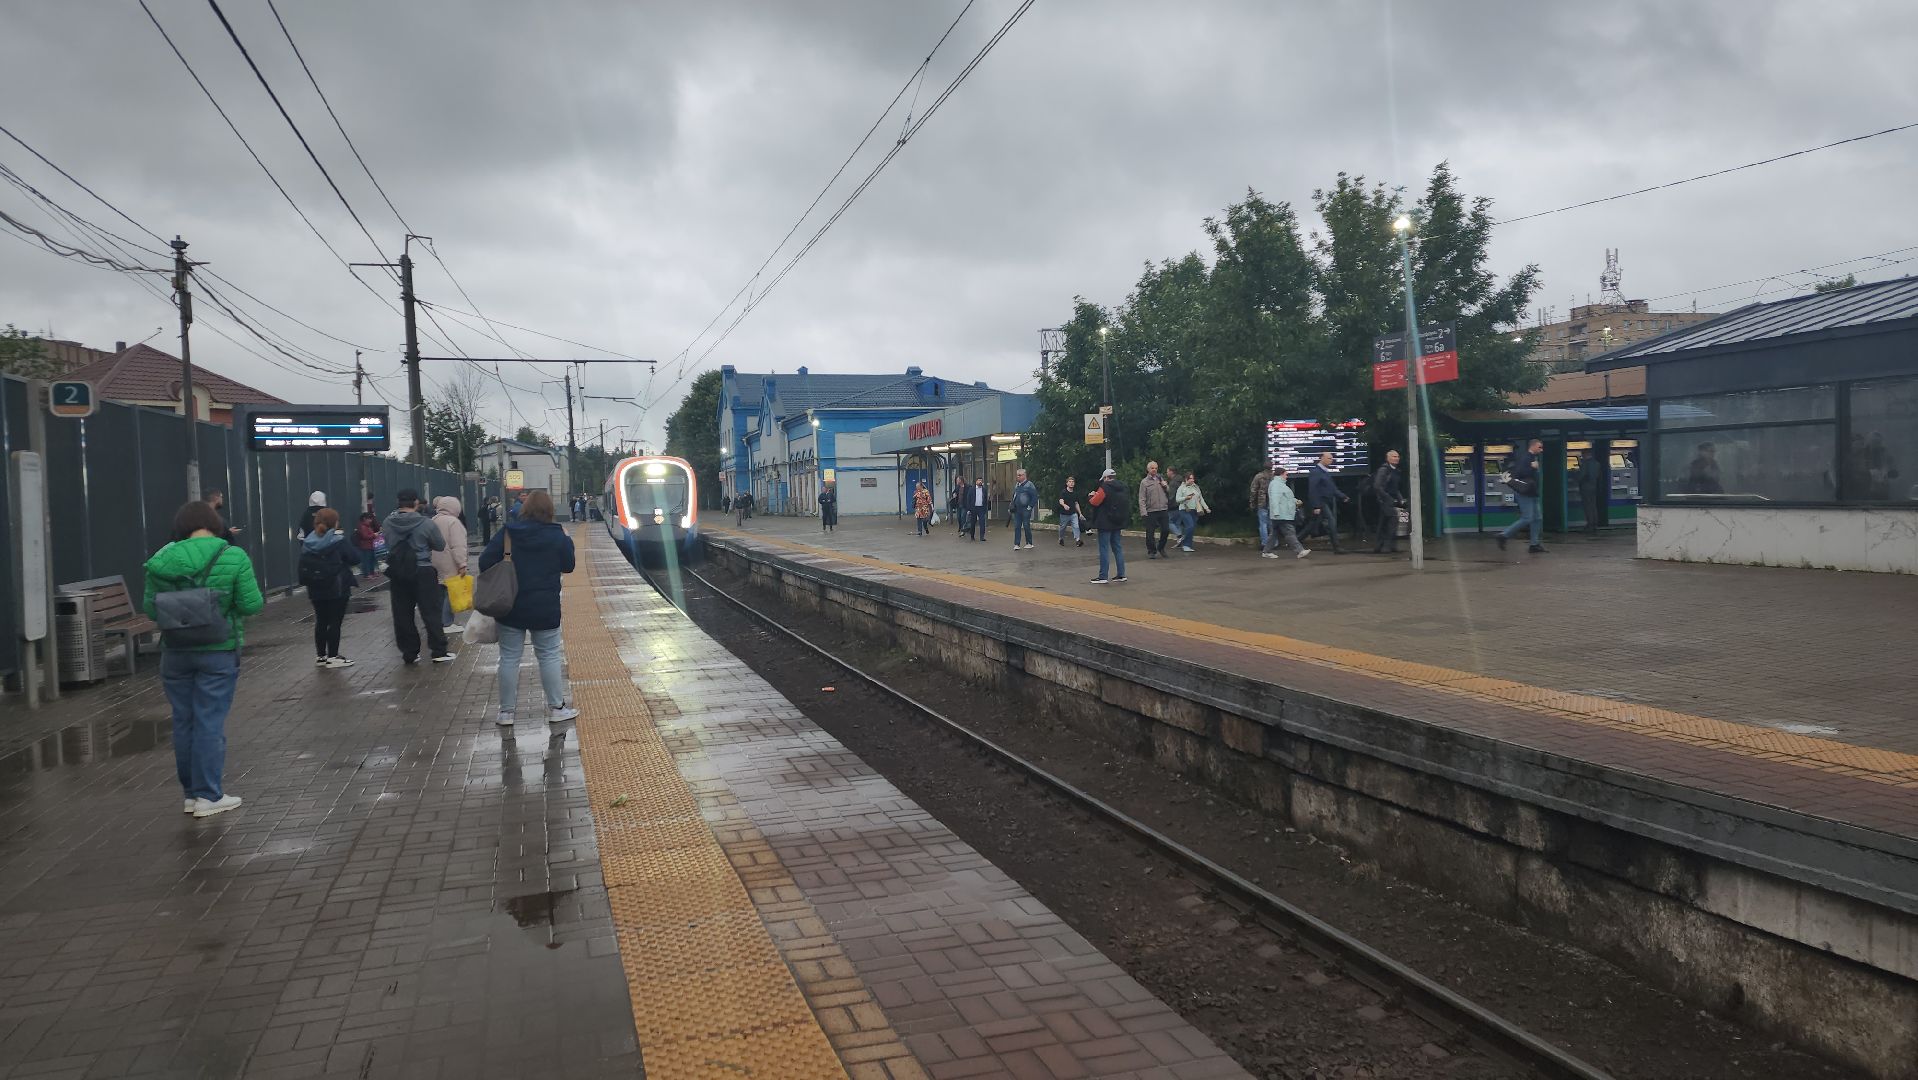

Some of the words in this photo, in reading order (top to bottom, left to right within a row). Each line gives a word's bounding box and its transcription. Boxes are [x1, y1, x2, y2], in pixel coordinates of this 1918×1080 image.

[1438, 329, 1443, 339] 2
[1380, 340, 1384, 350] 2
[1380, 352, 1385, 362] 6
[65, 386, 79, 404] 2
